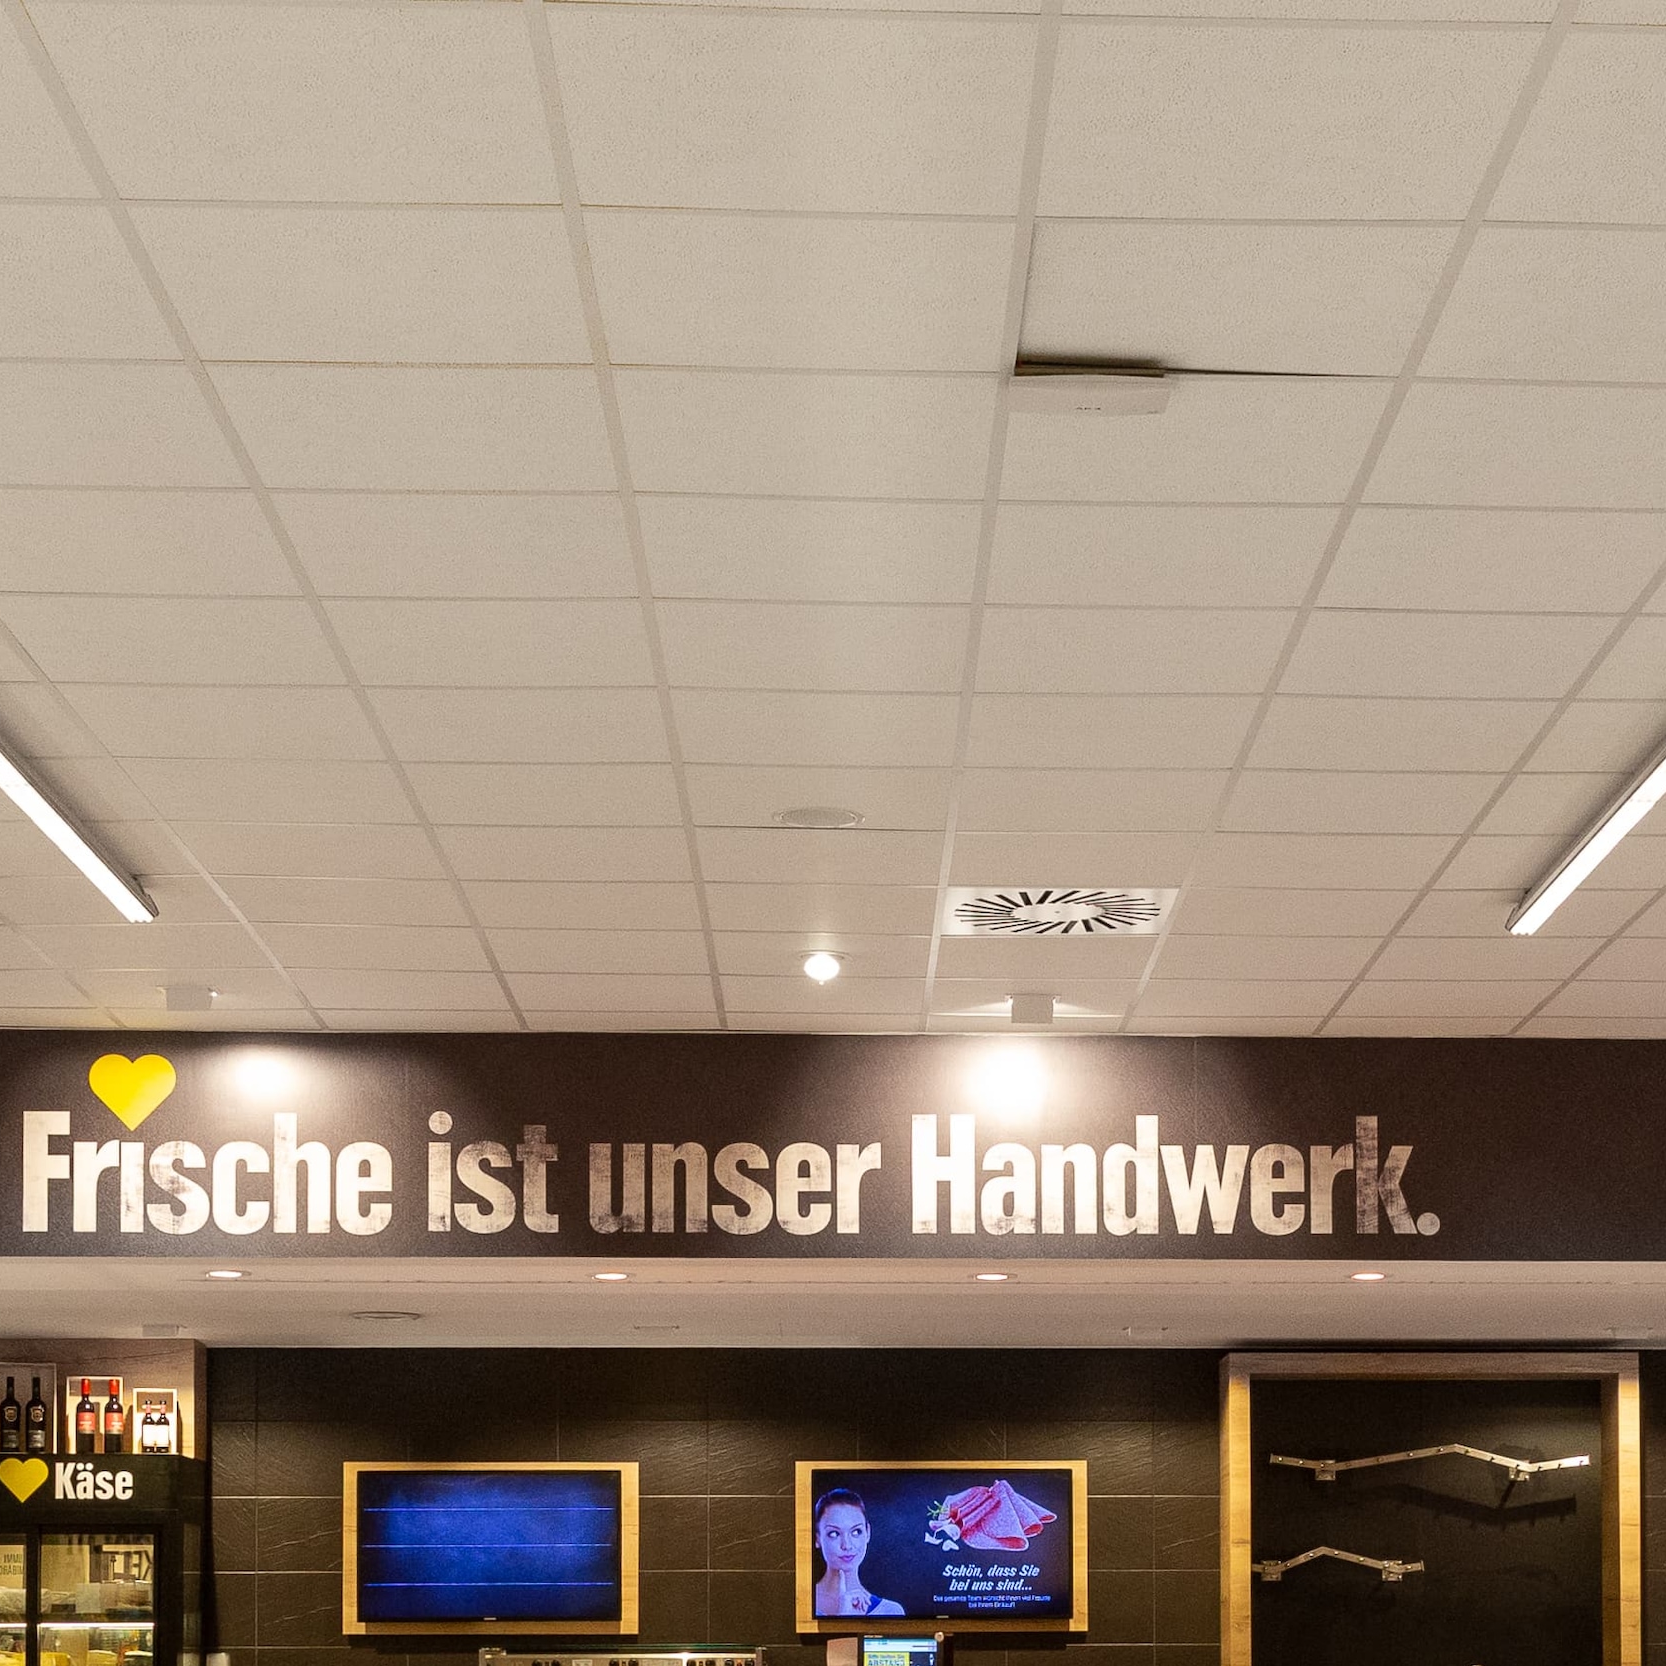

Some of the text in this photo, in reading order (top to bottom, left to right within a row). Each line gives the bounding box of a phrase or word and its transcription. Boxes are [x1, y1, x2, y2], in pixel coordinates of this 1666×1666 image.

[22, 1110, 1443, 1237] Frische ist unser Handwerk.
[55, 1462, 133, 1500] Käse
[942, 1565, 1040, 1578] Schön, dass Sie
[949, 1579, 1033, 1592] bei uns sind...
